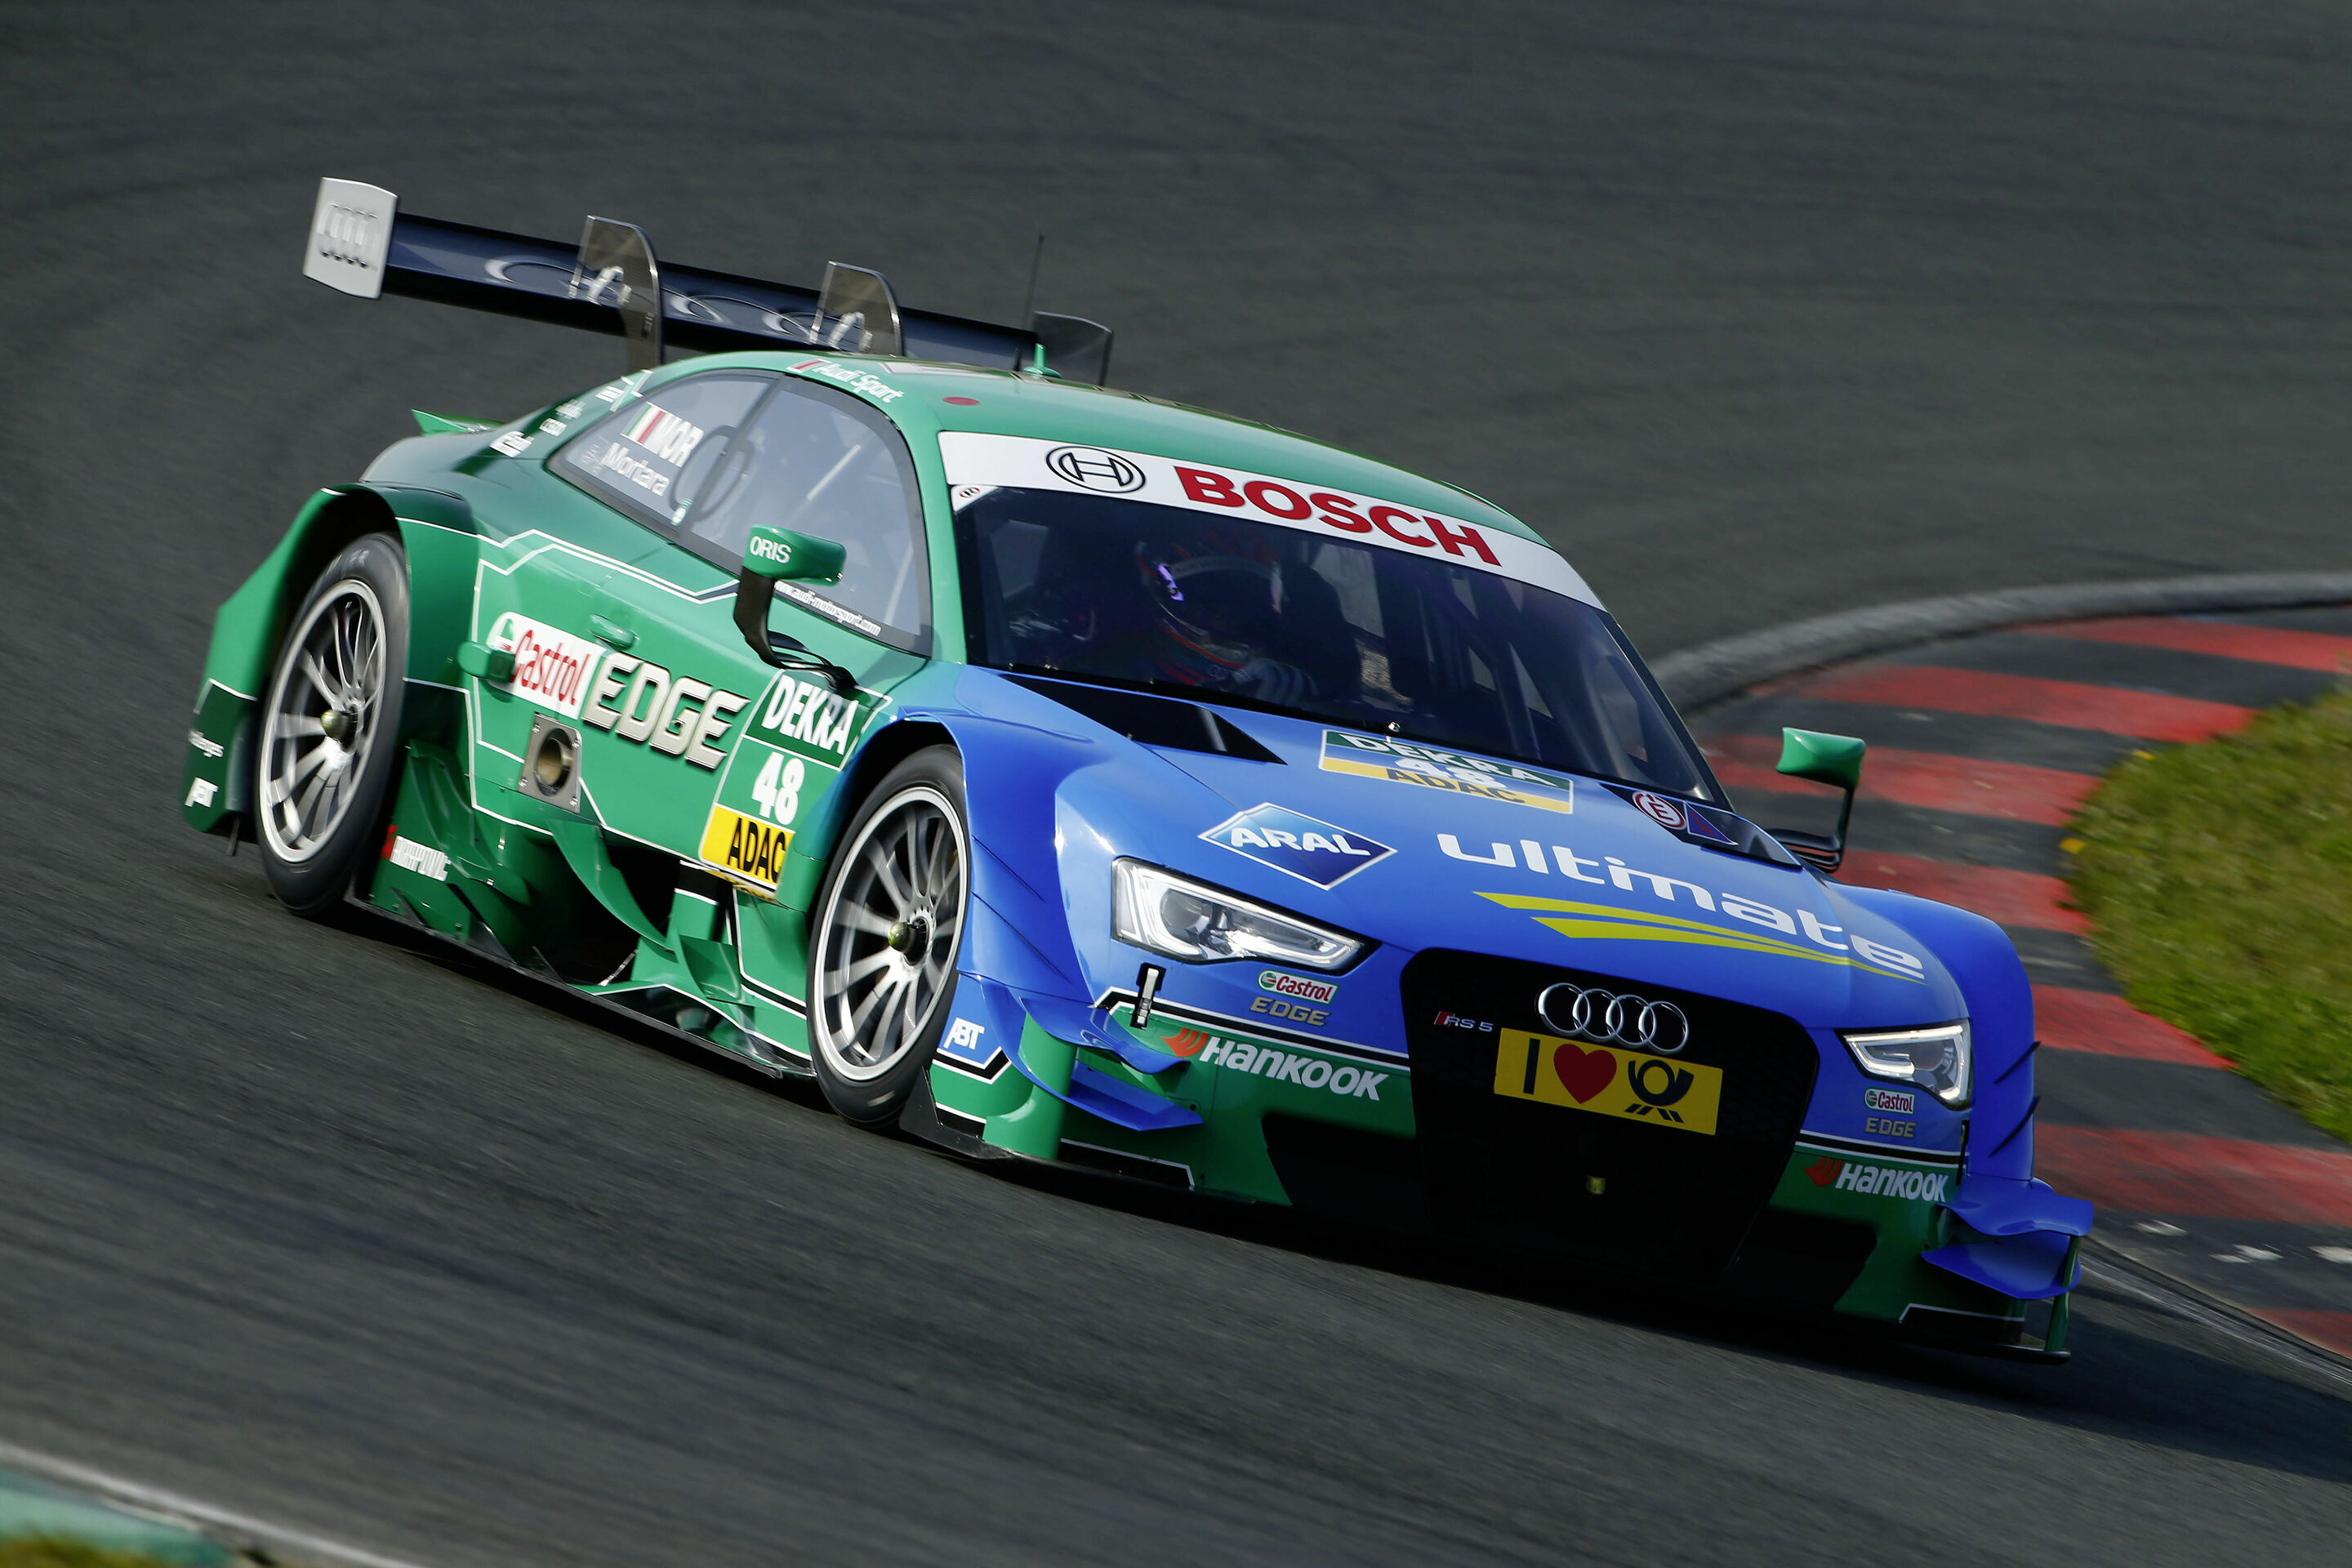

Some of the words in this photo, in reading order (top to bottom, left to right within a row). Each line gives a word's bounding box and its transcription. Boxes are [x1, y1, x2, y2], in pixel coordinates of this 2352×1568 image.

[812, 363, 866, 382] Audi
[851, 374, 904, 403] Sport
[599, 442, 670, 497] Mortara
[1174, 466, 1502, 567] BOSCH
[750, 536, 792, 564] ORIS
[511, 630, 590, 706] Castrol
[581, 651, 751, 773] EDGE
[761, 675, 859, 755] DEKRA
[1339, 733, 1557, 786] DEKRA
[1394, 757, 1507, 789] 48
[751, 751, 804, 825] 48
[1386, 768, 1526, 804] ADAC
[728, 817, 786, 883] ADAC
[1231, 826, 1371, 858] ARAL
[1437, 832, 1925, 980] ultimate
[1276, 976, 1333, 1002] Castrol
[1250, 996, 1330, 1027] EDGE
[1444, 1015, 1476, 1029] RS
[1478, 1022, 1494, 1032] 5
[943, 1017, 985, 1050] ABT
[1523, 1038, 1541, 1095] I
[1878, 1092, 1913, 1112] Castrol
[1865, 1117, 1917, 1138] EDGE
